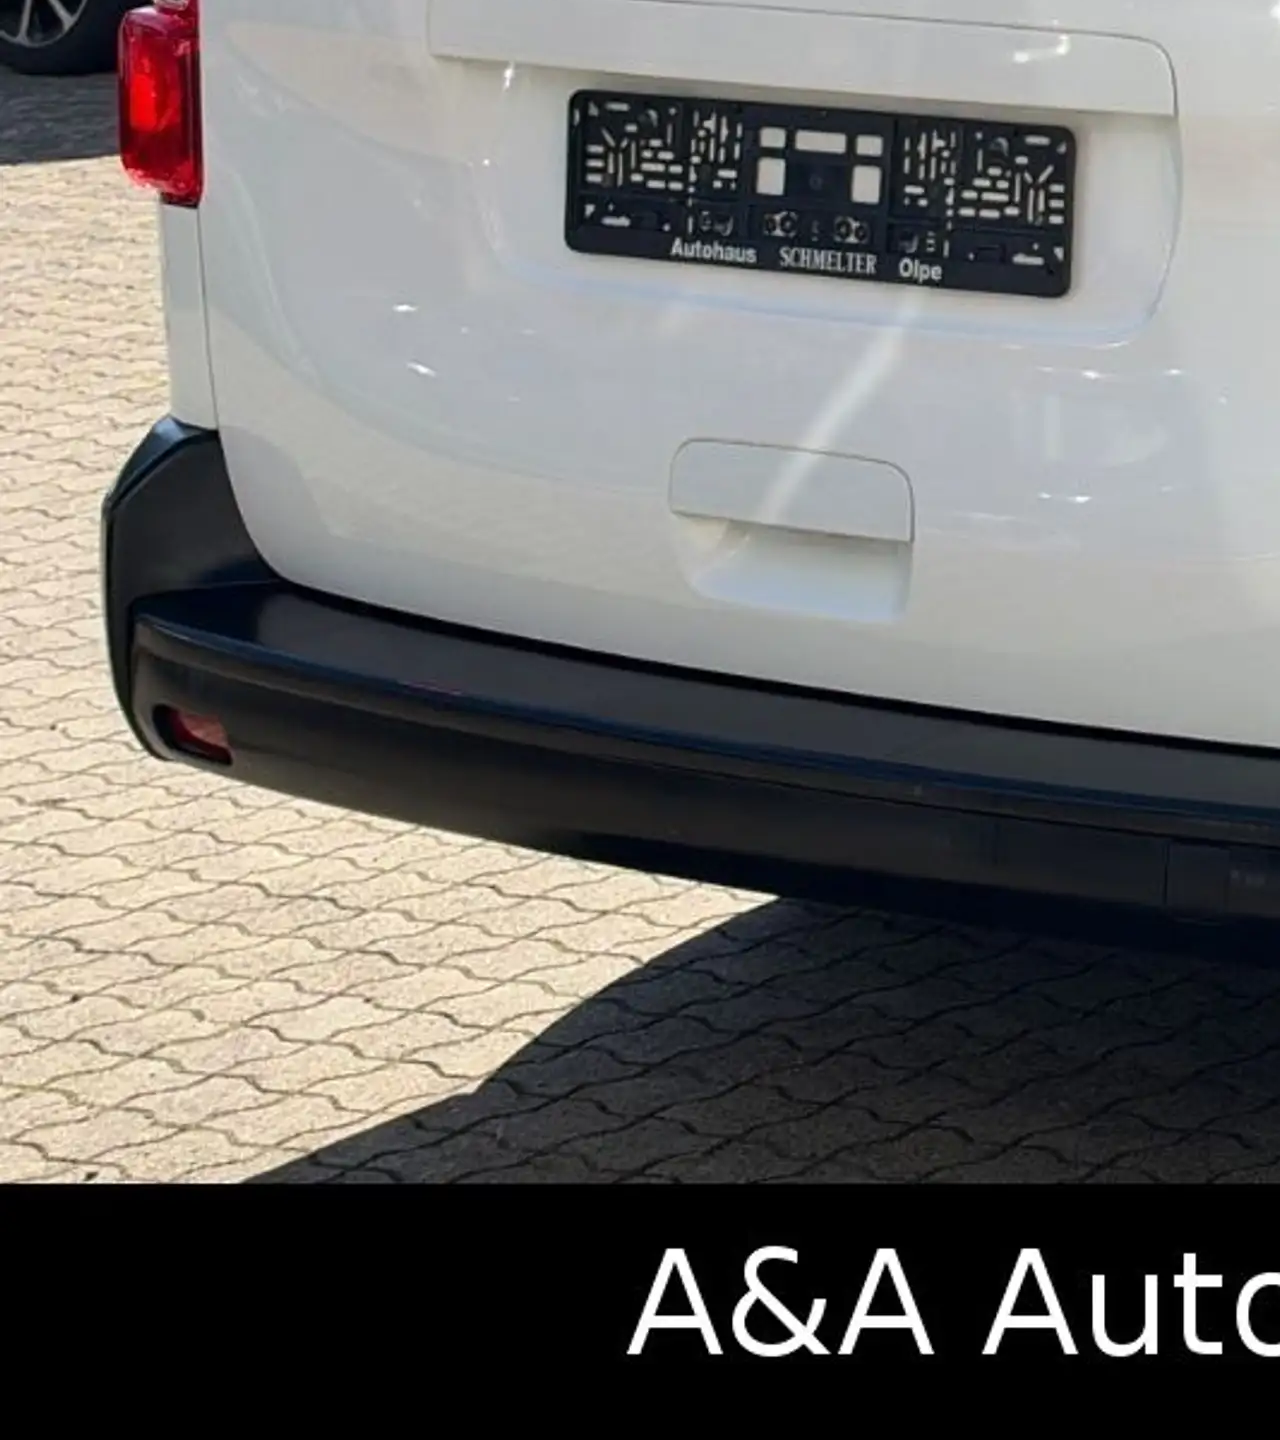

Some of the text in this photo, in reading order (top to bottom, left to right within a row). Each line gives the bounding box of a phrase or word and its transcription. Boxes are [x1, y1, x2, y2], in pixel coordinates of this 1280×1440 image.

[670, 236, 943, 282] Autohaus SCHMELTER Olpe
